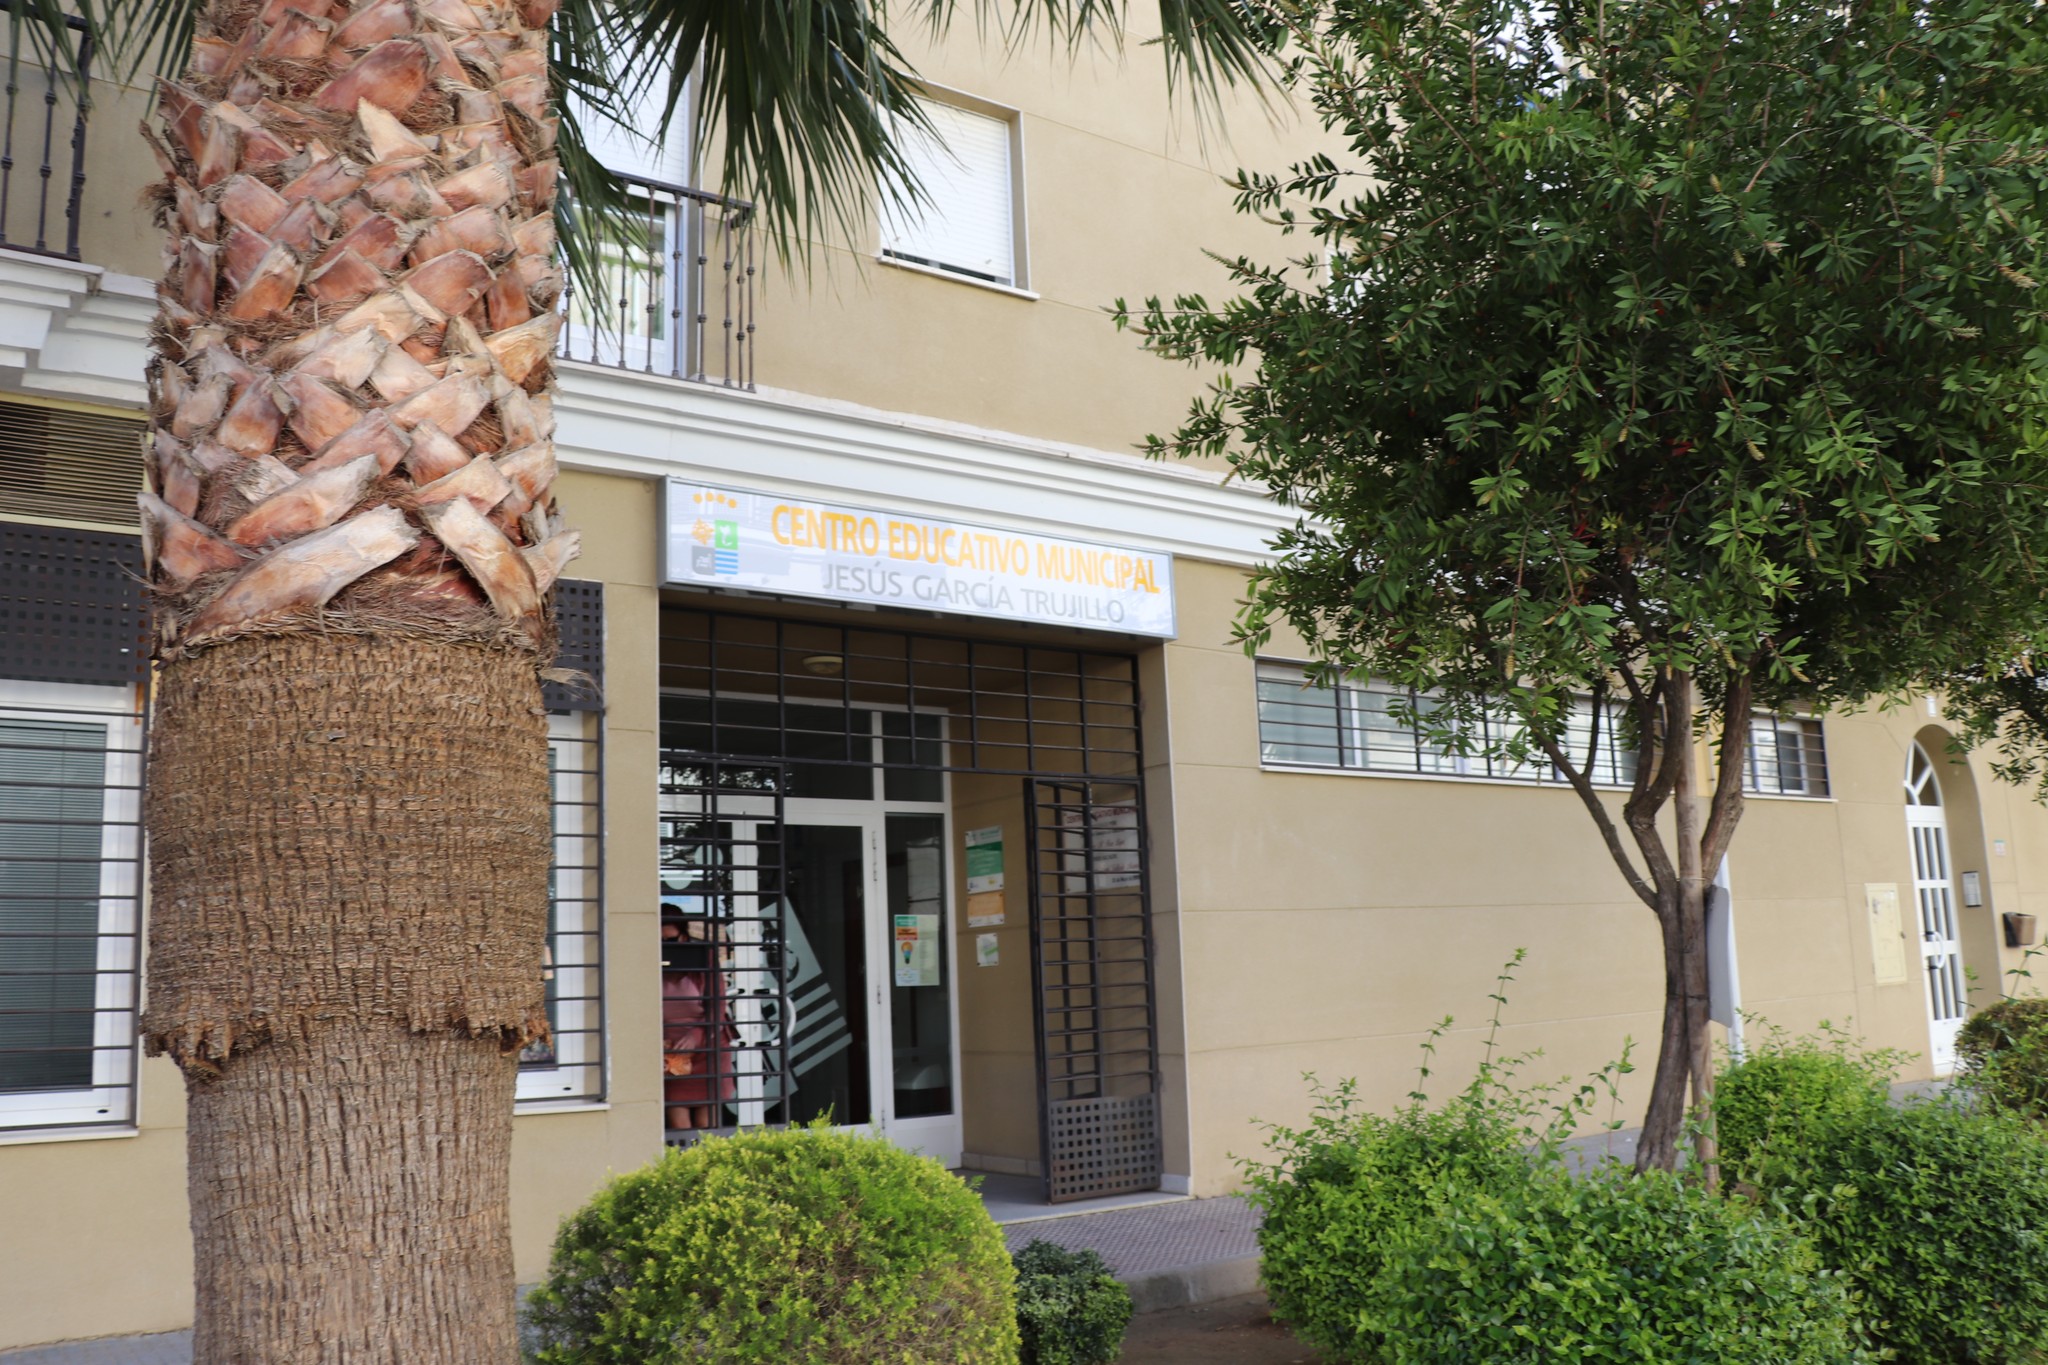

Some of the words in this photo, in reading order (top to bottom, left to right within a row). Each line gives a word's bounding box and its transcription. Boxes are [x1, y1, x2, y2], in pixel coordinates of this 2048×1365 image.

[771, 504, 880, 557] CENTRO
[888, 520, 1030, 576] EDUCATIVO
[1036, 543, 1161, 594] MUNICIPAL
[822, 560, 903, 597] JESÚS
[912, 575, 1015, 611] GARCÍA
[1020, 588, 1125, 624] TRUJILLO
